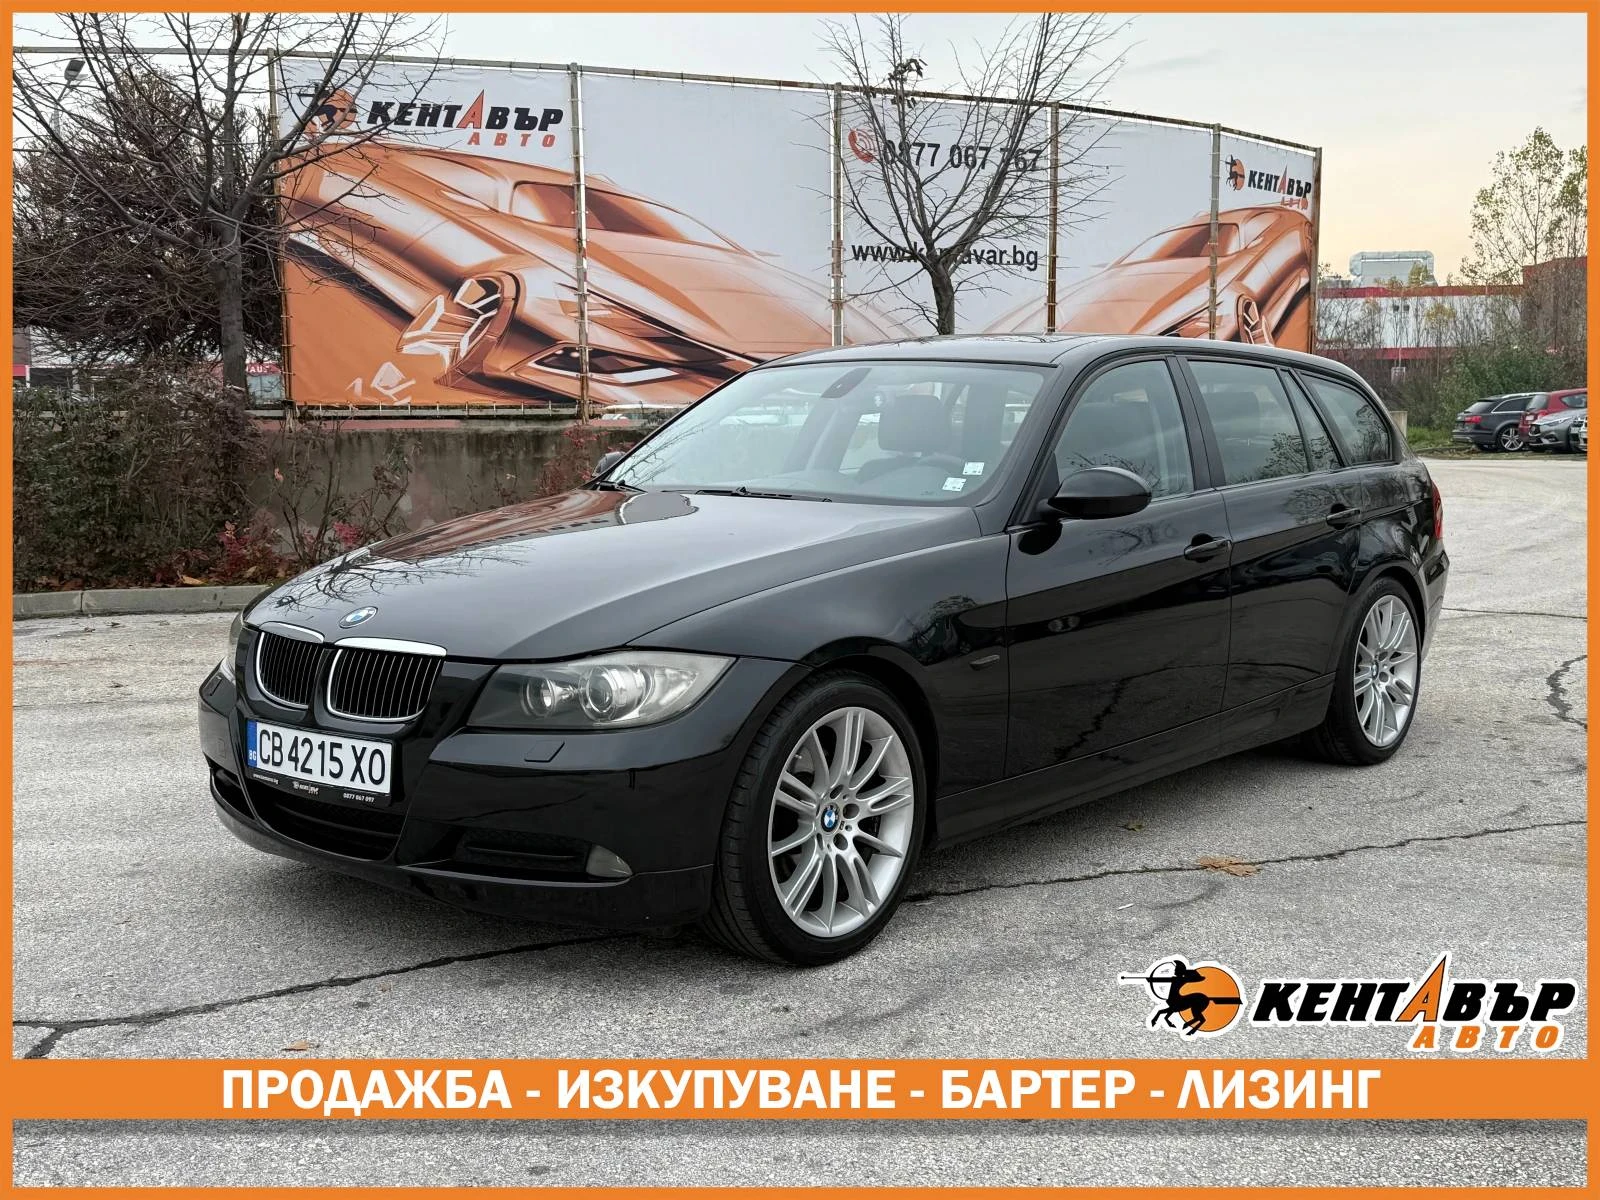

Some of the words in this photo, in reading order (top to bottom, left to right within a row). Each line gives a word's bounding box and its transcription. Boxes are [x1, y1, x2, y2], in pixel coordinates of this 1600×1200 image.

[367, 89, 563, 132] КЕНТАВЪР
[467, 132, 556, 148] АВТО
[949, 144, 991, 170] 067
[1248, 164, 1311, 198] КЕНТАВЪР
[852, 242, 1039, 272] www.kavar.bg
[249, 750, 257, 761] BG
[259, 729, 284, 767] CB
[287, 735, 344, 779] 4215
